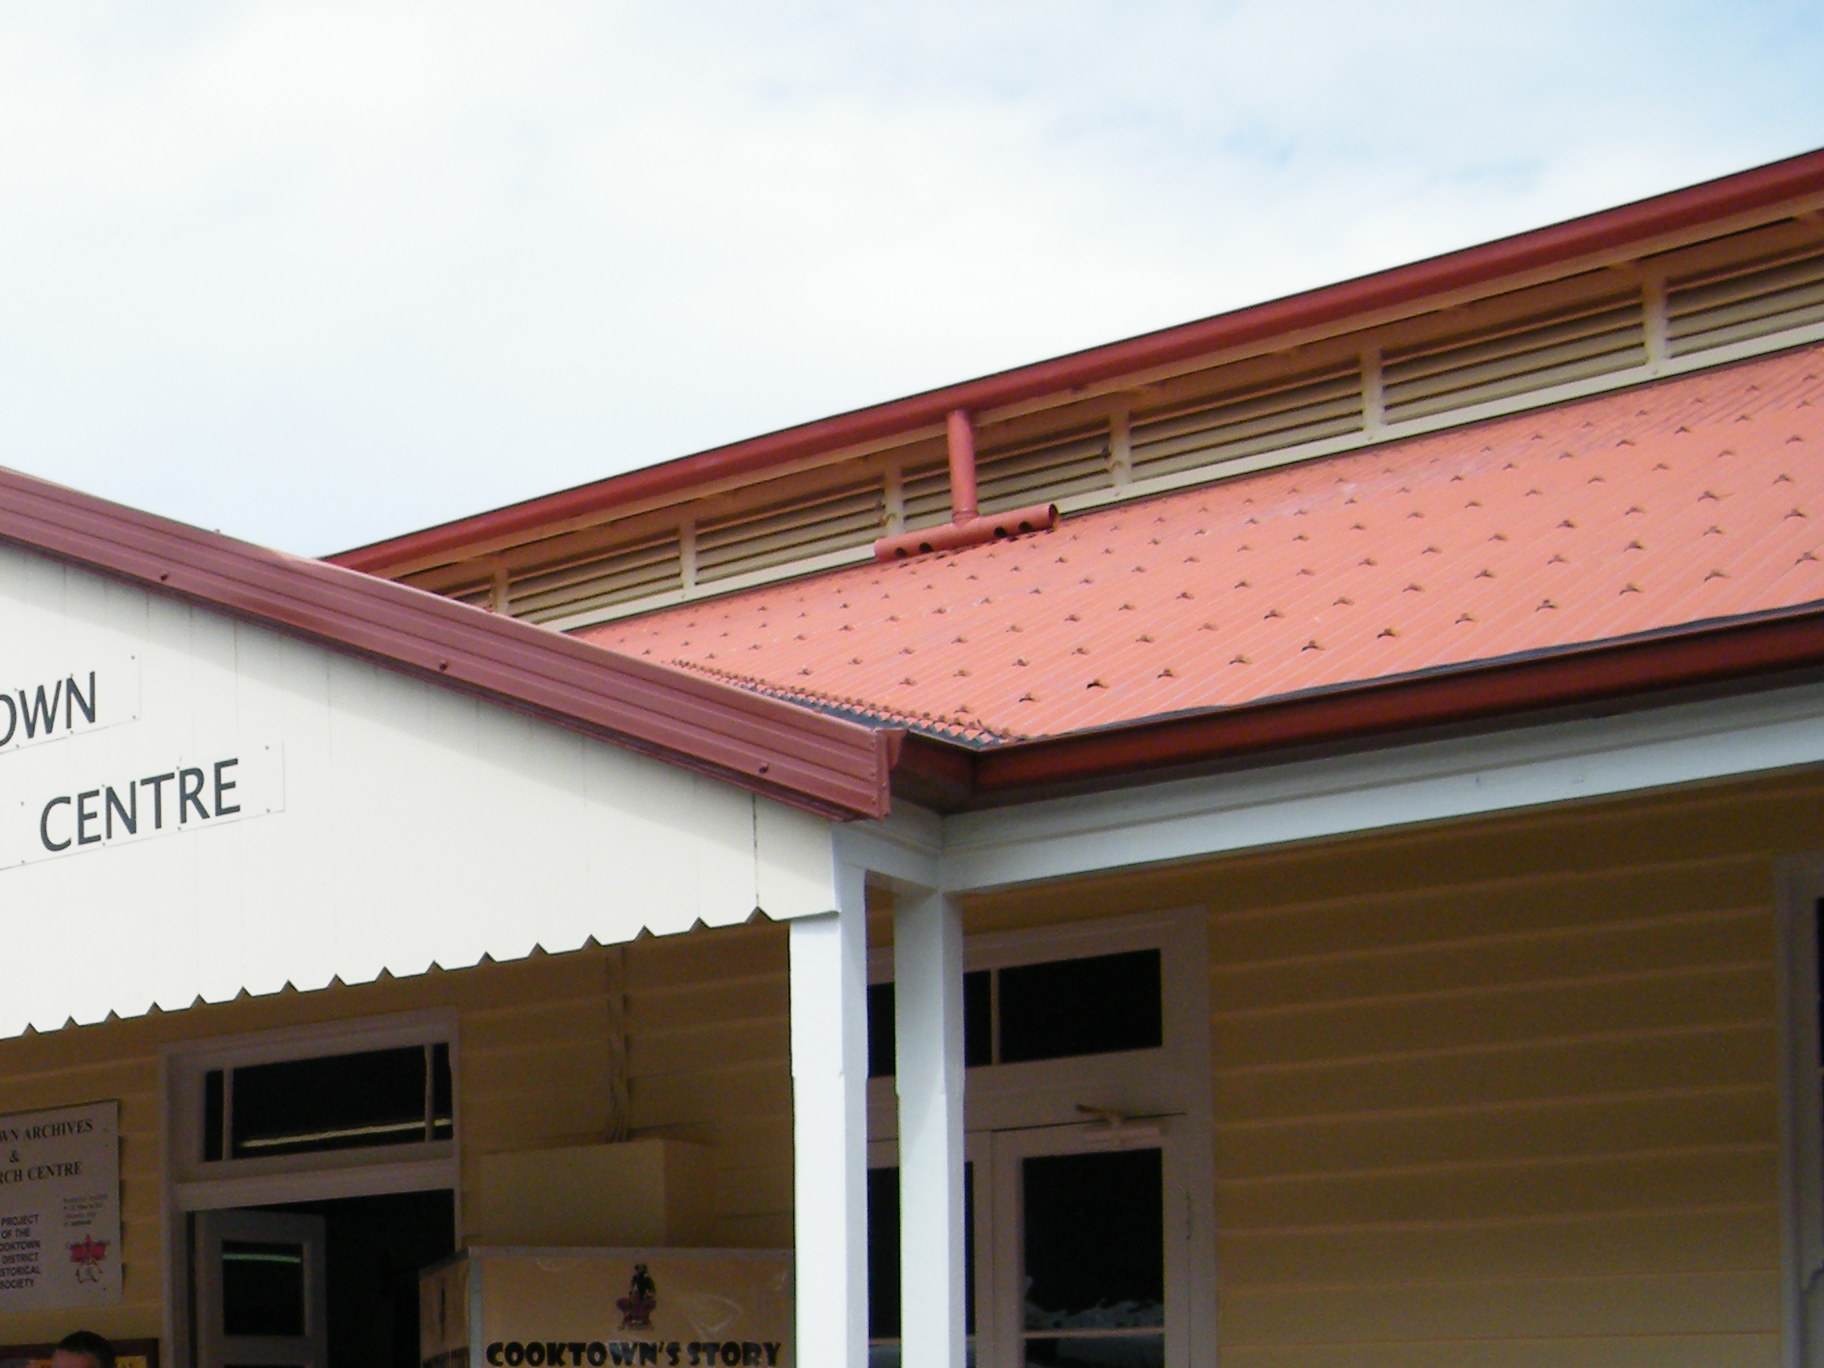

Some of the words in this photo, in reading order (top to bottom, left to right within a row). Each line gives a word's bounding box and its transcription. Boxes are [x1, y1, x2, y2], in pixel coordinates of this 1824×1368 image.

[40, 758, 241, 852] CENTRE
[23, 1118, 93, 1141] ARCHIVES
[9, 1150, 20, 1163] &
[27, 1161, 82, 1181] CENTRE
[1, 1214, 39, 1226] PROJECT
[1, 1230, 12, 1239] OF
[15, 1227, 30, 1238] THE
[2, 1253, 39, 1264] DISTRICT
[0, 1278, 34, 1289] SOCIETY
[486, 1341, 681, 1367] COOKTOWN'S
[687, 1341, 781, 1366] STORY
